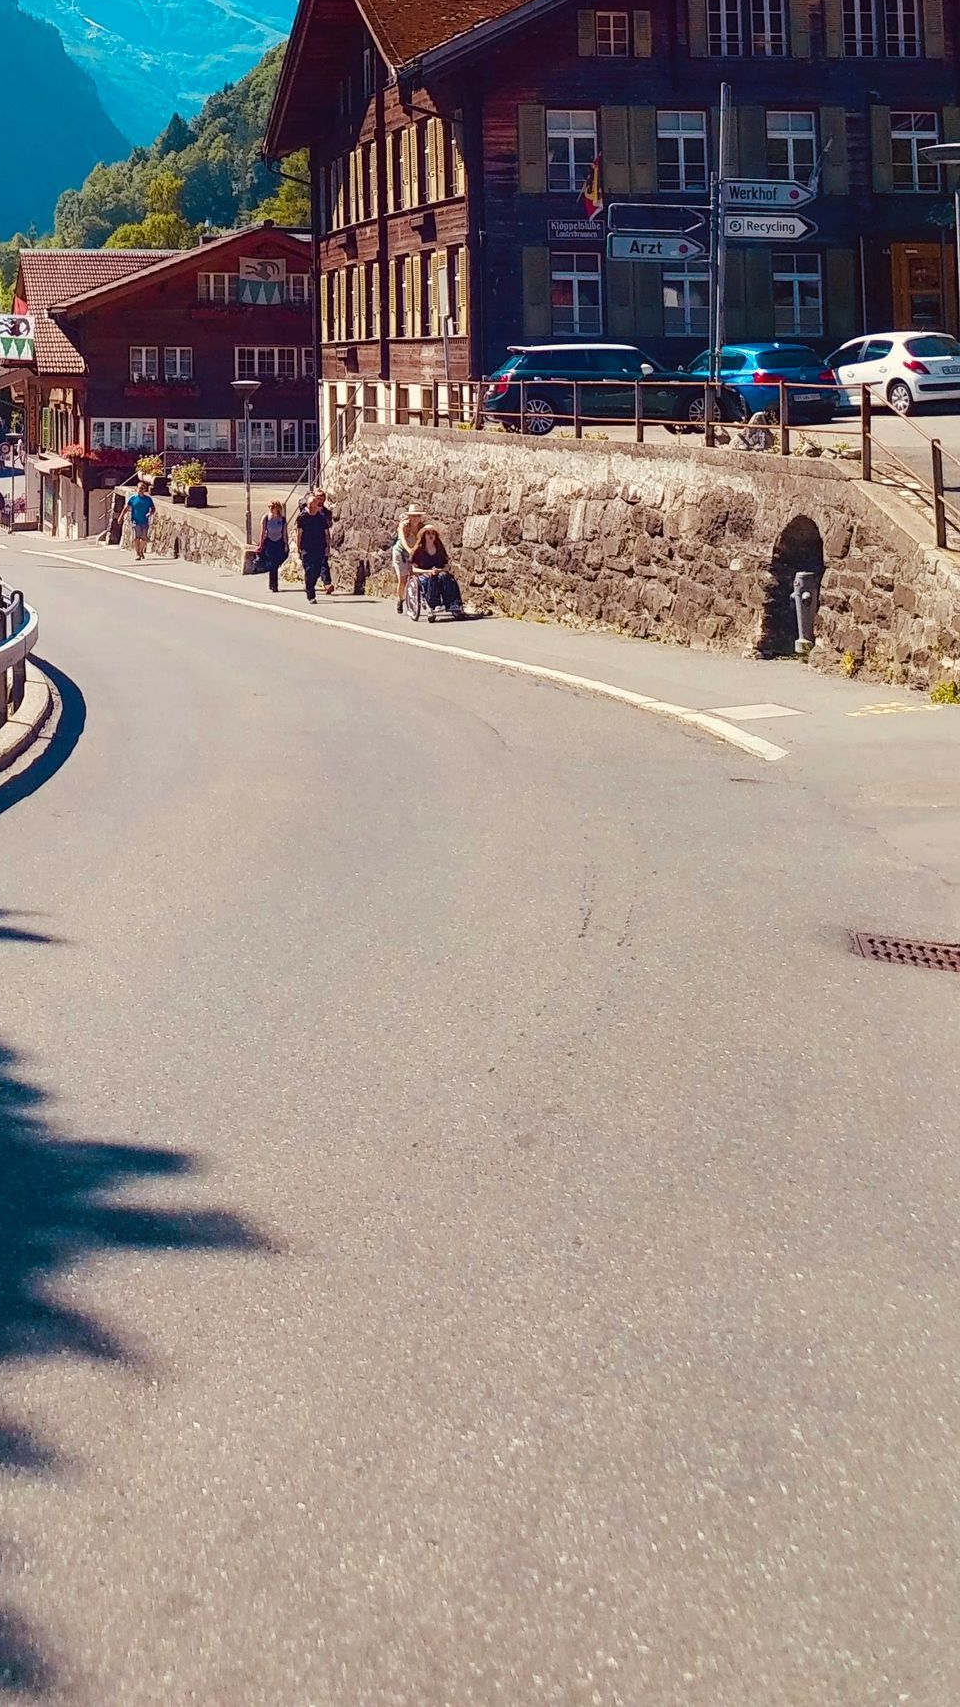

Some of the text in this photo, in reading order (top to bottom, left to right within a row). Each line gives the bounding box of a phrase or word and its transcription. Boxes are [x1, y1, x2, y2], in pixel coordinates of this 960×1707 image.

[729, 185, 777, 201] Werkhof
[746, 221, 796, 234] Recycling
[629, 240, 663, 255] Arzt
